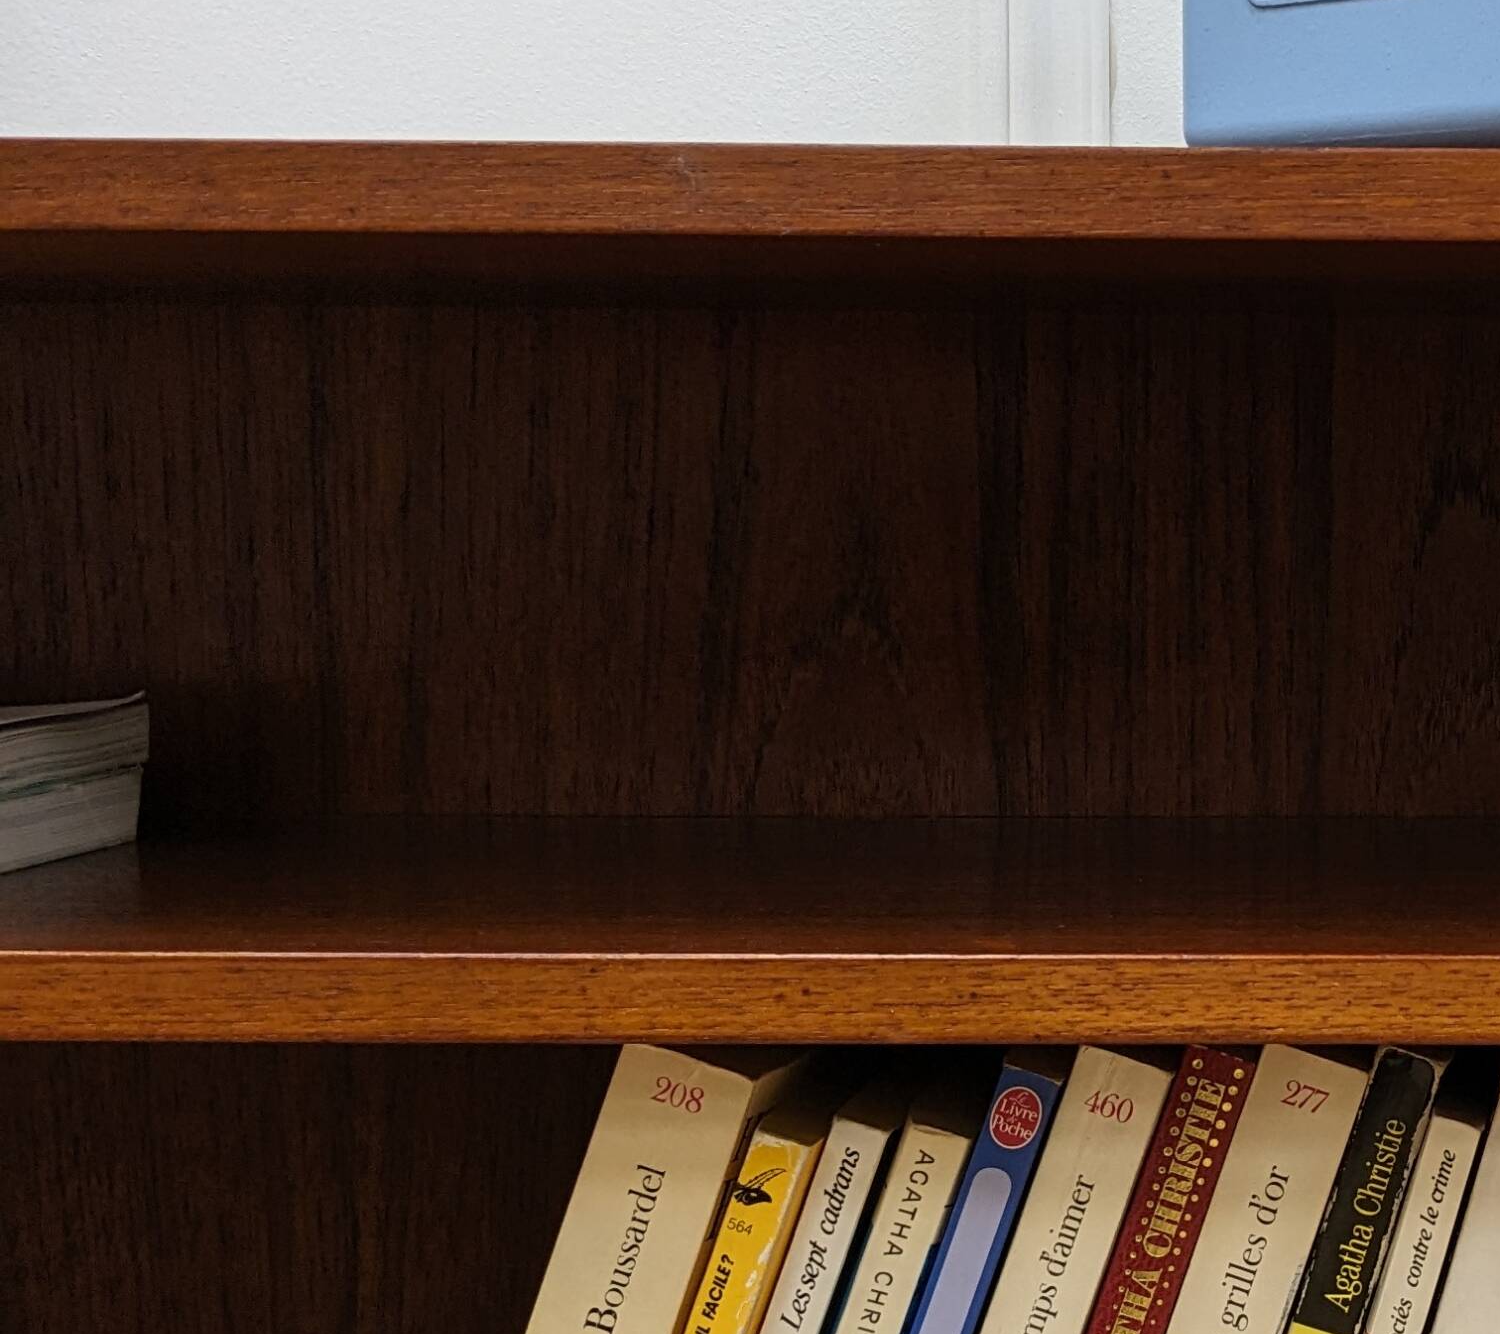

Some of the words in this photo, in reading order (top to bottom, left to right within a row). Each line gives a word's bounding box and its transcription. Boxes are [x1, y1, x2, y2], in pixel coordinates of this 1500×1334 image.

[650, 1075, 705, 1114] 208
[1000, 1099, 1037, 1122] Livre
[1084, 1090, 1134, 1123] 460
[1280, 1079, 1330, 1113] 277
[993, 1114, 1033, 1140] Poche
[1143, 1079, 1226, 1258] CHRISTIE
[1431, 1148, 1456, 1205] crime
[726, 1217, 753, 1235] 564
[883, 1149, 935, 1257] AGATHA
[1324, 1225, 1374, 1314] Agatha
[1353, 1118, 1406, 1217] Christie
[1419, 1204, 1439, 1226] le
[780, 1288, 811, 1332] Les
[800, 1239, 829, 1289] sept
[820, 1146, 860, 1236] cadrans
[1407, 1226, 1434, 1289] contre
[1221, 1231, 1267, 1332] grilles
